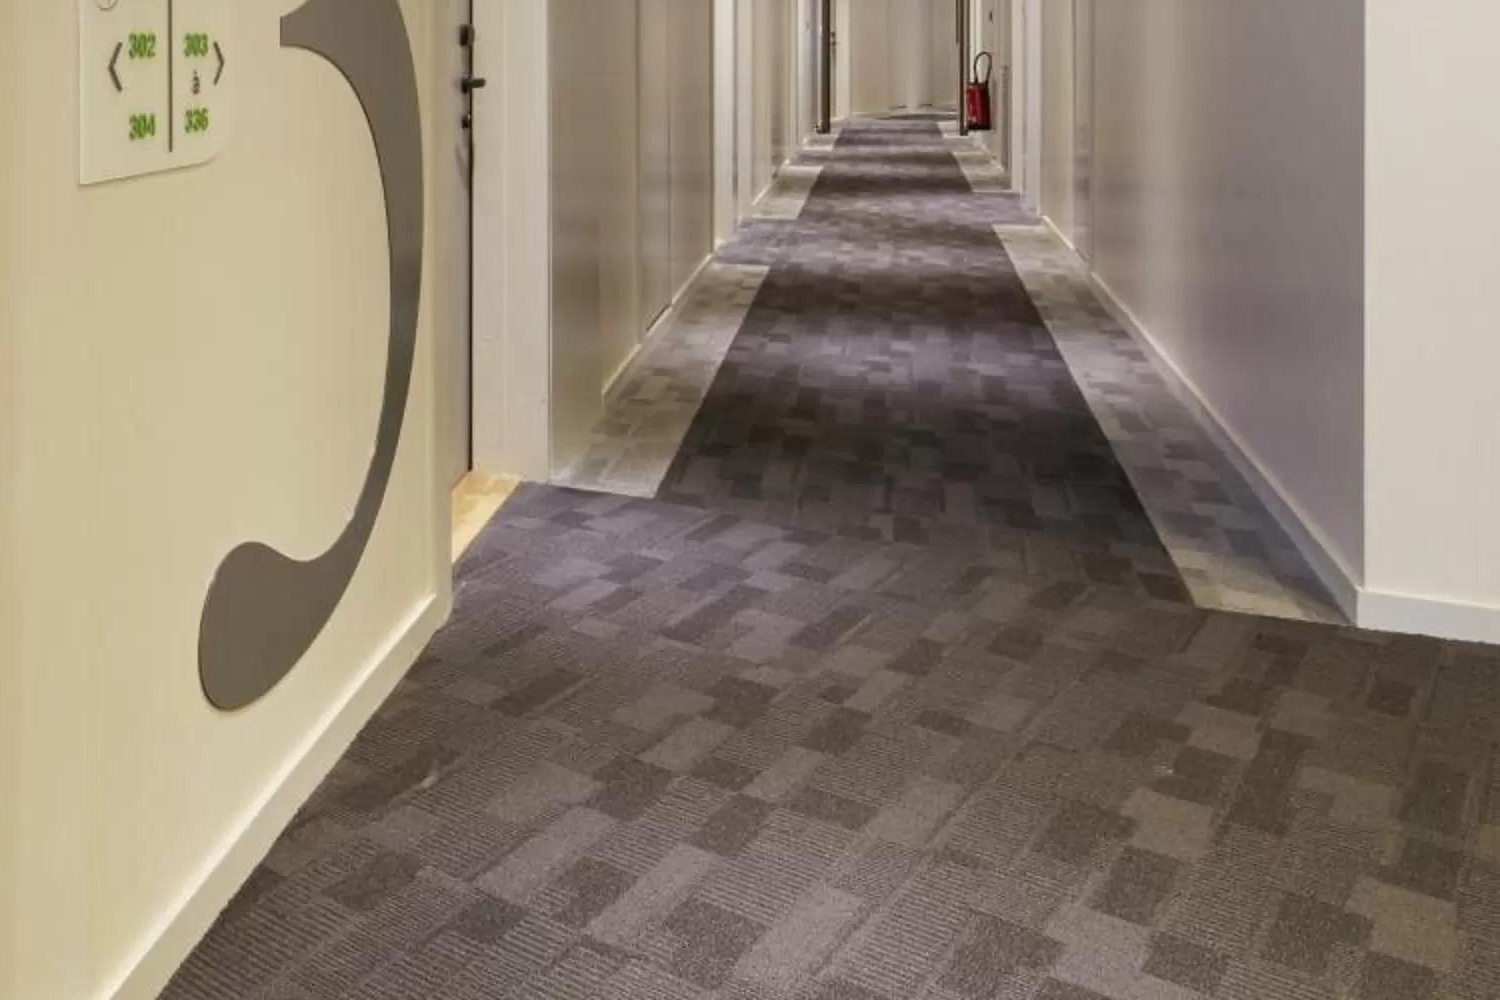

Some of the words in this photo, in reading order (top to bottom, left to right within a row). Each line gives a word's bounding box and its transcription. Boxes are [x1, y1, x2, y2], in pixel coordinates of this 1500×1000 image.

[128, 32, 156, 59] 302
[183, 32, 209, 57] 303
[129, 112, 156, 141] 304
